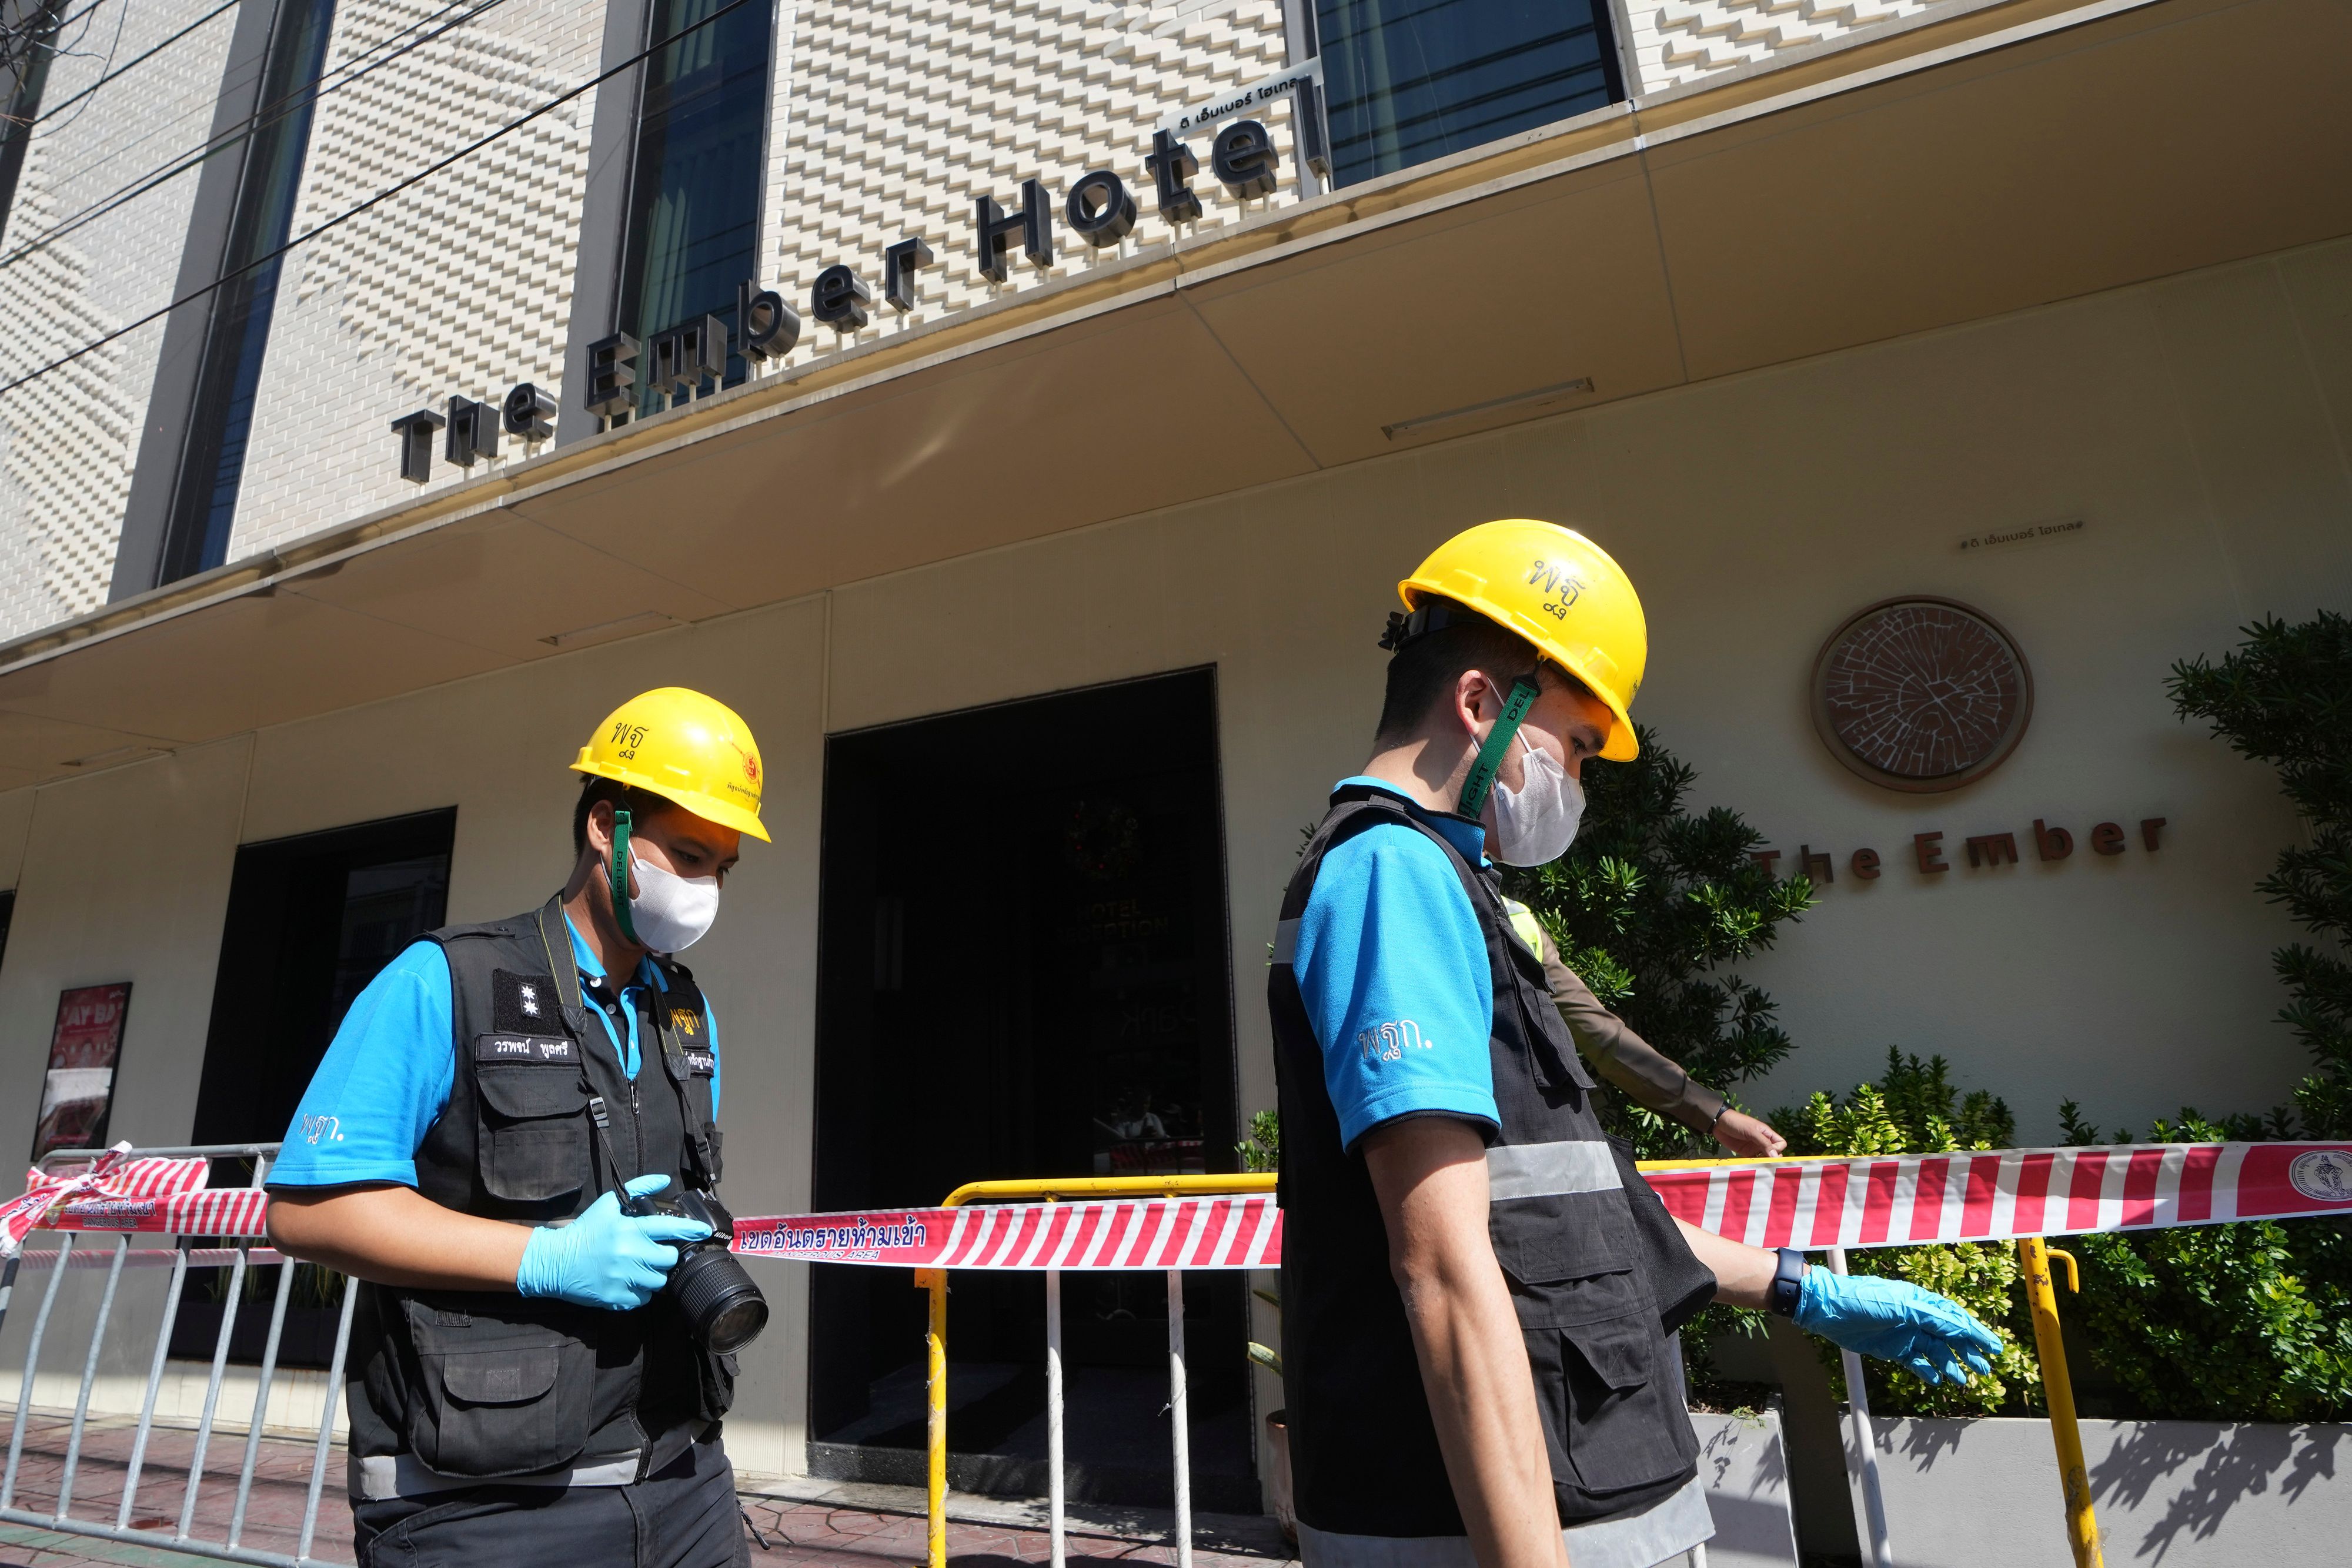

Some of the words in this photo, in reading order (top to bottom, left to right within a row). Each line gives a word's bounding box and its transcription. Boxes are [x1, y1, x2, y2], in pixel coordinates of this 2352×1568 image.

[1196, 92, 1252, 123] เอ็มเบอร์
[391, 382, 556, 483] The
[584, 236, 934, 416] Ember
[975, 75, 1331, 284] Hotel
[1984, 528, 2034, 546] เอ็มเบอร์
[2039, 523, 2074, 536] โฮเทล
[1750, 844, 1881, 884] The
[1913, 817, 2167, 874] Ember
[83, 1217, 119, 1228] DANGEROUS
[121, 1218, 138, 1229] AREA
[714, 1231, 733, 1241] Nikon
[740, 1213, 926, 1251] เขตอันตรายห้ามเข้า
[843, 1250, 880, 1260] AREA
